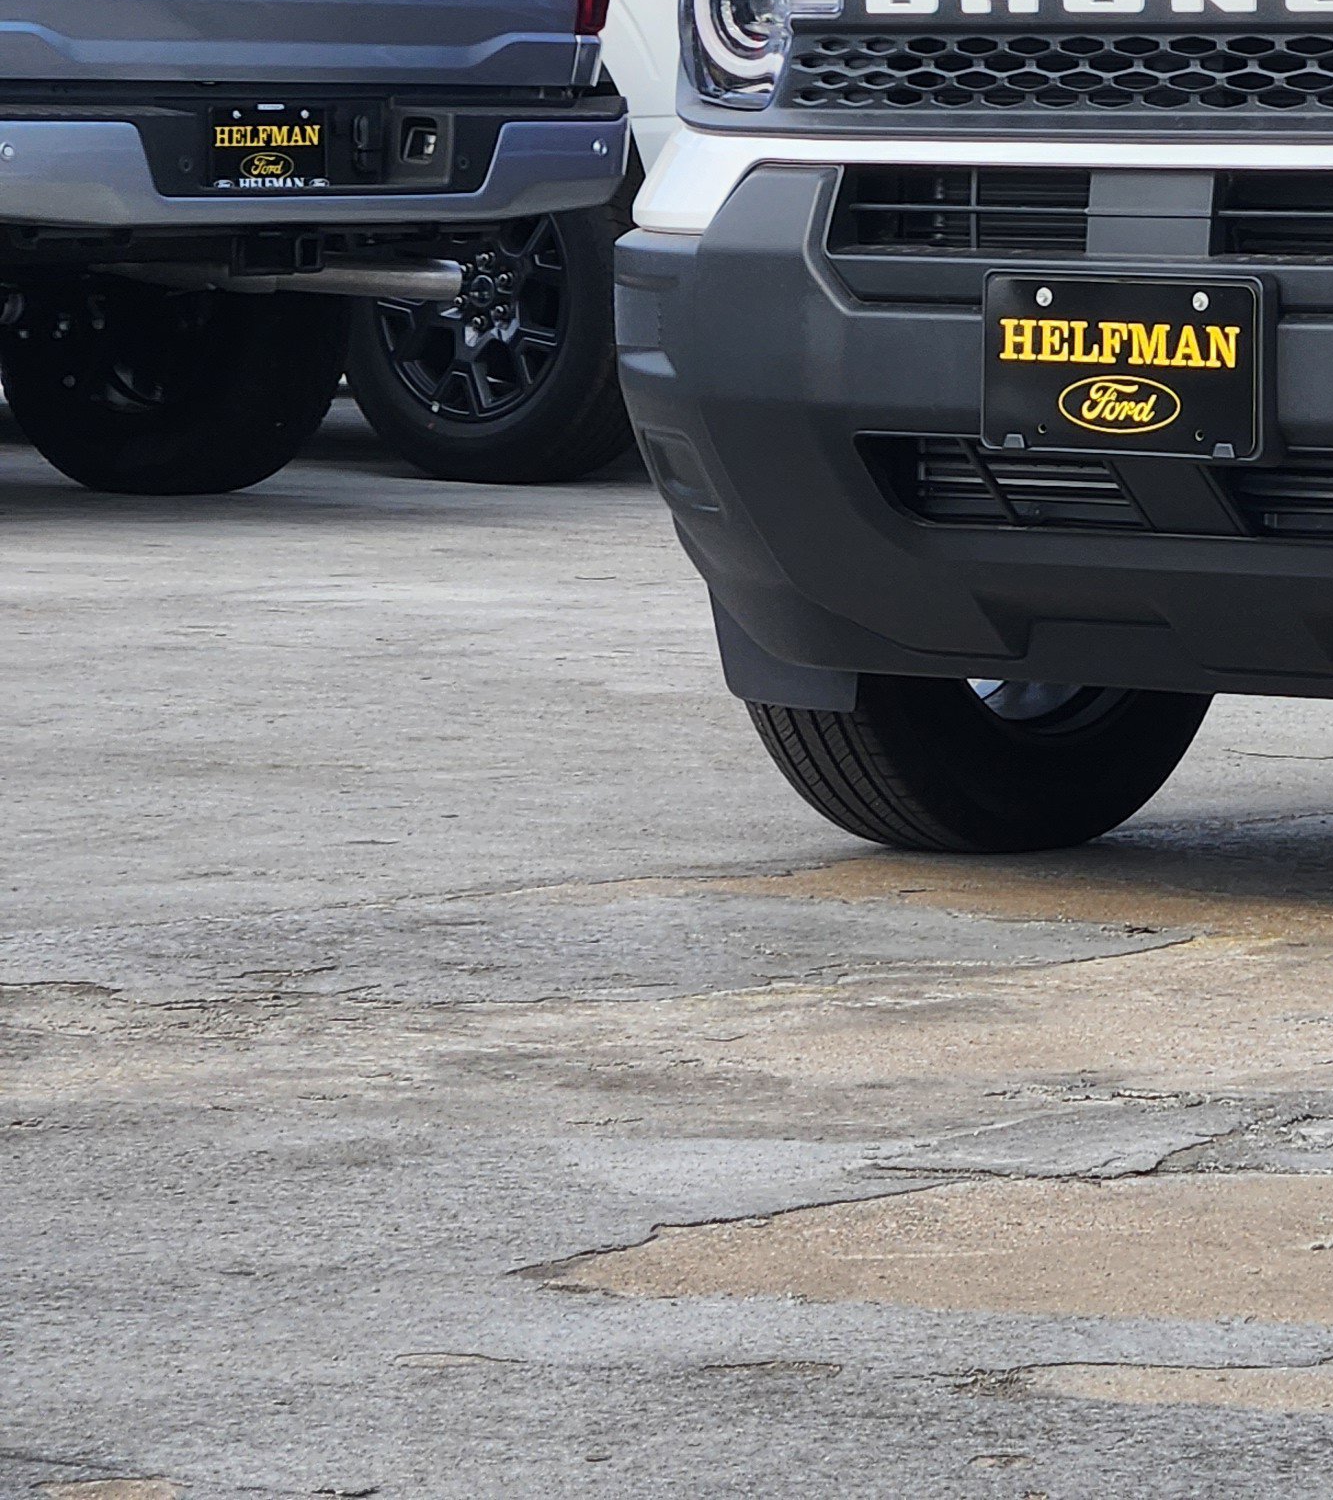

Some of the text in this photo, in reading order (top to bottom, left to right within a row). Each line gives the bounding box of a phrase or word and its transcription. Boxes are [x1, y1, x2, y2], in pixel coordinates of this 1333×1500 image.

[214, 125, 320, 147] HELFMAN
[251, 155, 284, 175] Ford
[999, 318, 1241, 369] HELFMAN
[1081, 381, 1158, 423] Ford
